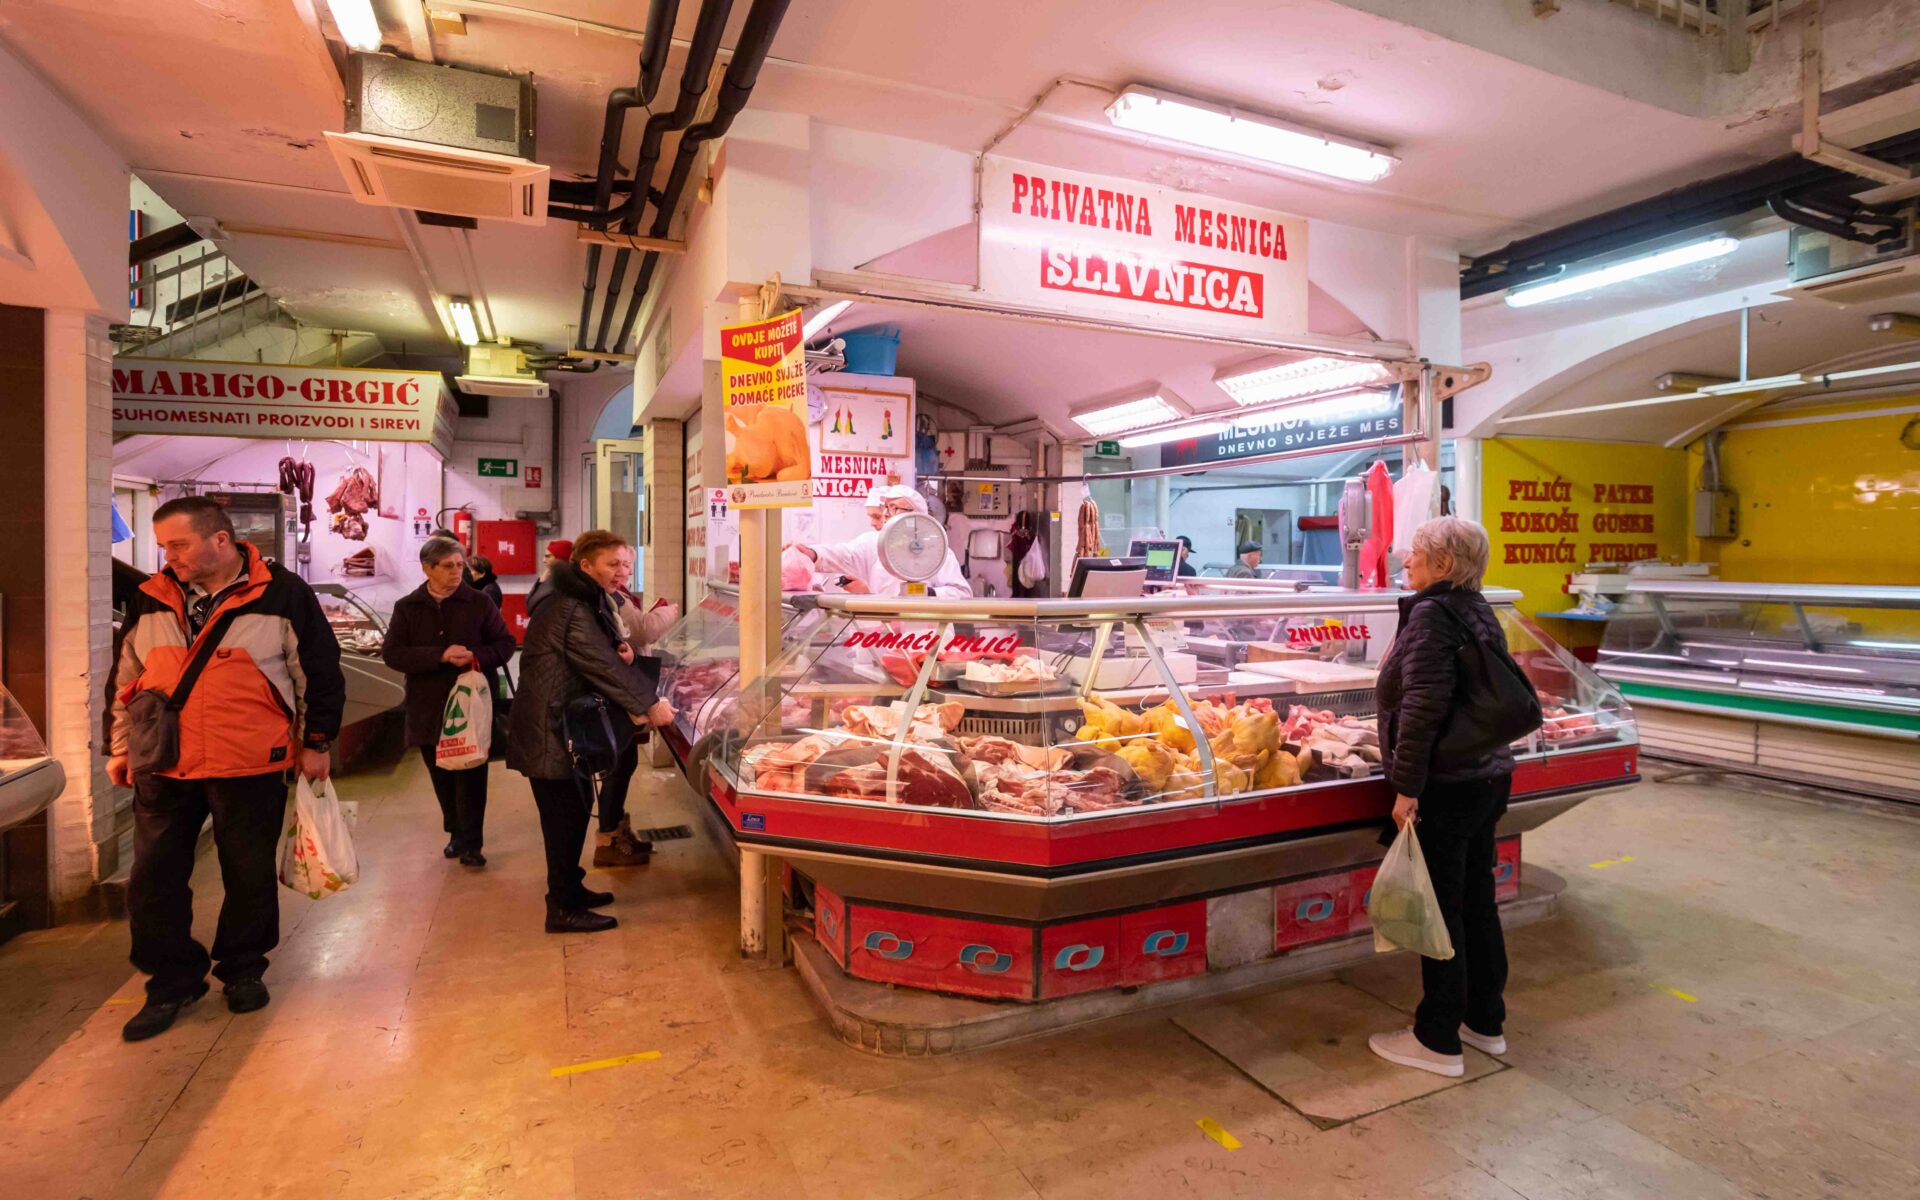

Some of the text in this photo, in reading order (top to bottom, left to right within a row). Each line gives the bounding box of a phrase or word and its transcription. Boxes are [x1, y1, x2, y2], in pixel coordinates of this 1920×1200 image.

[1012, 173, 1287, 261] PRIVATNA MESNICA
[1046, 245, 1259, 314] SLIVNICA
[731, 321, 797, 348] OVDJE MOŽETE
[754, 341, 784, 360] KUPITI
[112, 368, 419, 406] MARIGO-GRGIĆ
[730, 370, 773, 388] DNEVNO
[730, 382, 805, 406] DOMAĆE PICEKE
[112, 408, 420, 430] SUHOMESNATI PROIZVODI I SIREVI
[1218, 436, 1277, 456] DNEVNO
[1284, 424, 1350, 446] SVJEŽE
[821, 455, 887, 476] MESNICA
[1509, 475, 1654, 504] PILIĆI PATKE
[1500, 506, 1654, 533] KOKOŠI GUSKE
[1504, 537, 1576, 564] KUNIĆI
[843, 630, 1023, 654] DOMAĆI PILIĆI
[1286, 624, 1371, 643] ZNUTRICE
